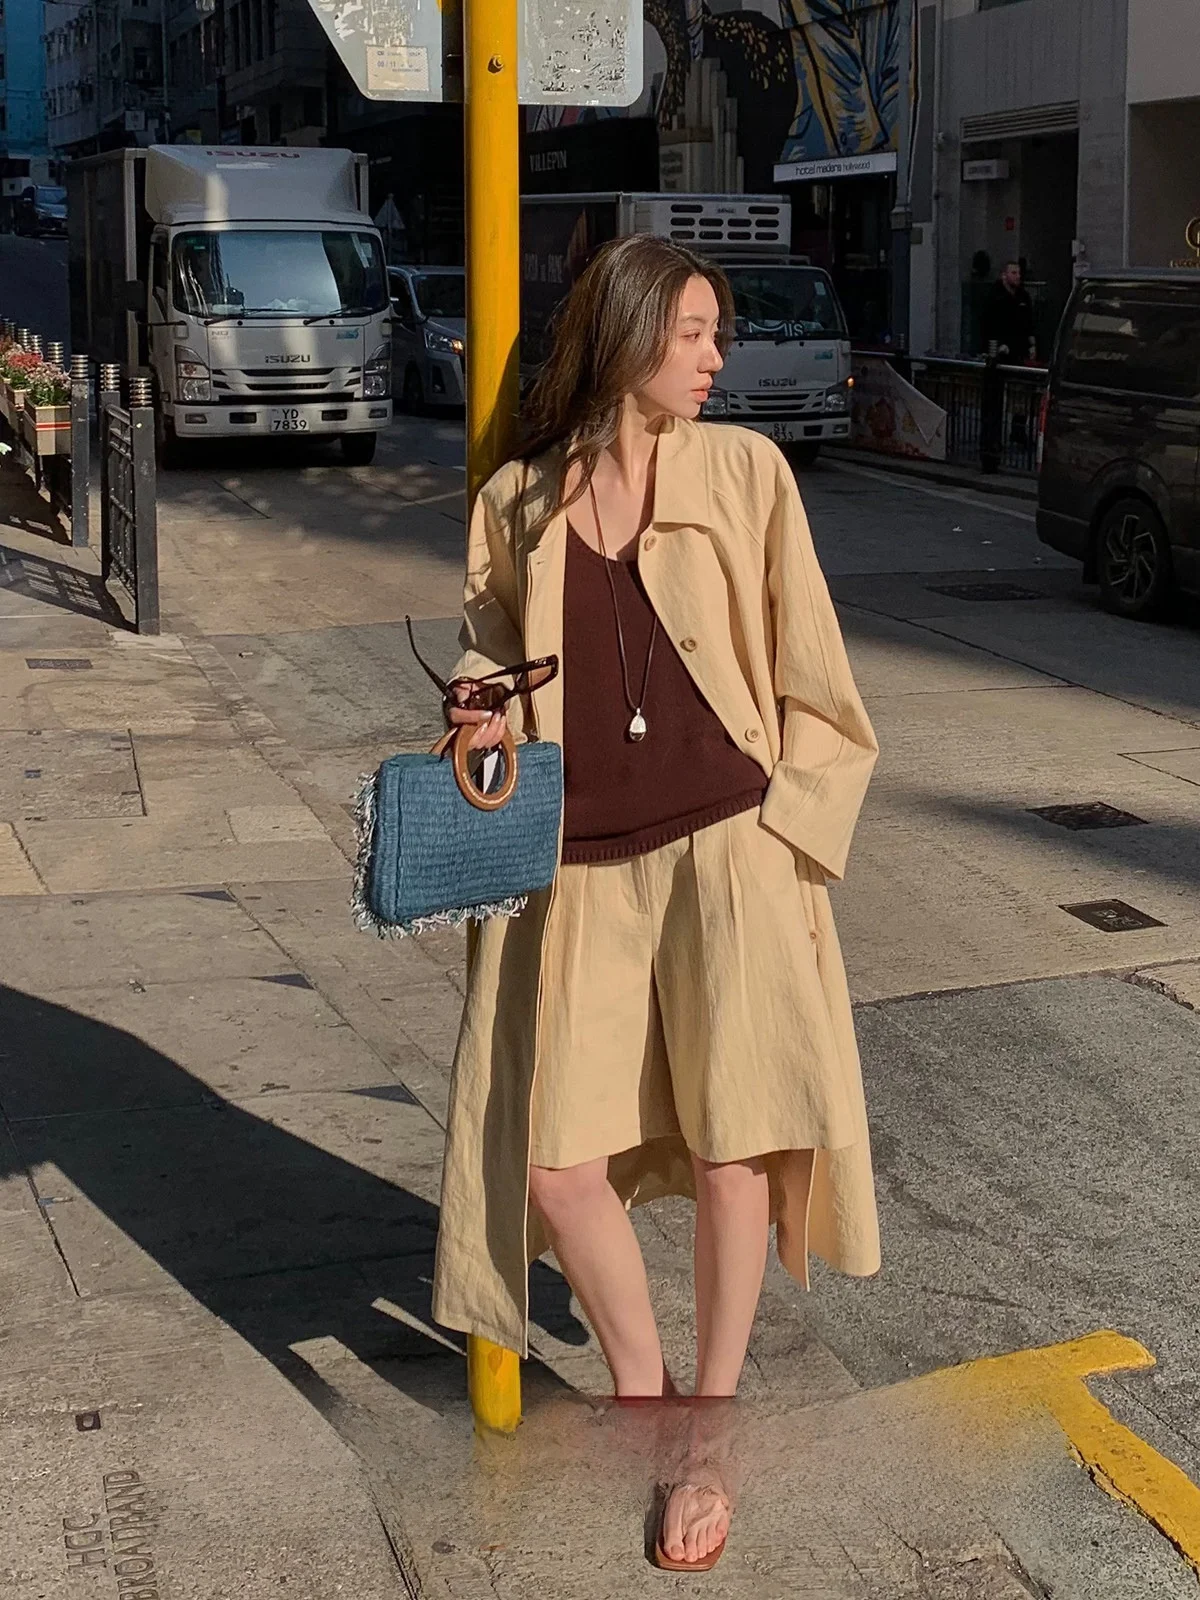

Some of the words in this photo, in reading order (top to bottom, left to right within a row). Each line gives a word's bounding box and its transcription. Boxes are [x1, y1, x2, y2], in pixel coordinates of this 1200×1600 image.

[529, 150, 568, 173] VILLEPIN
[795, 165, 815, 176] hotel
[265, 354, 311, 364] ISUZU
[759, 378, 797, 387] ISUZU
[282, 408, 299, 419] YD
[273, 419, 307, 431] 7839
